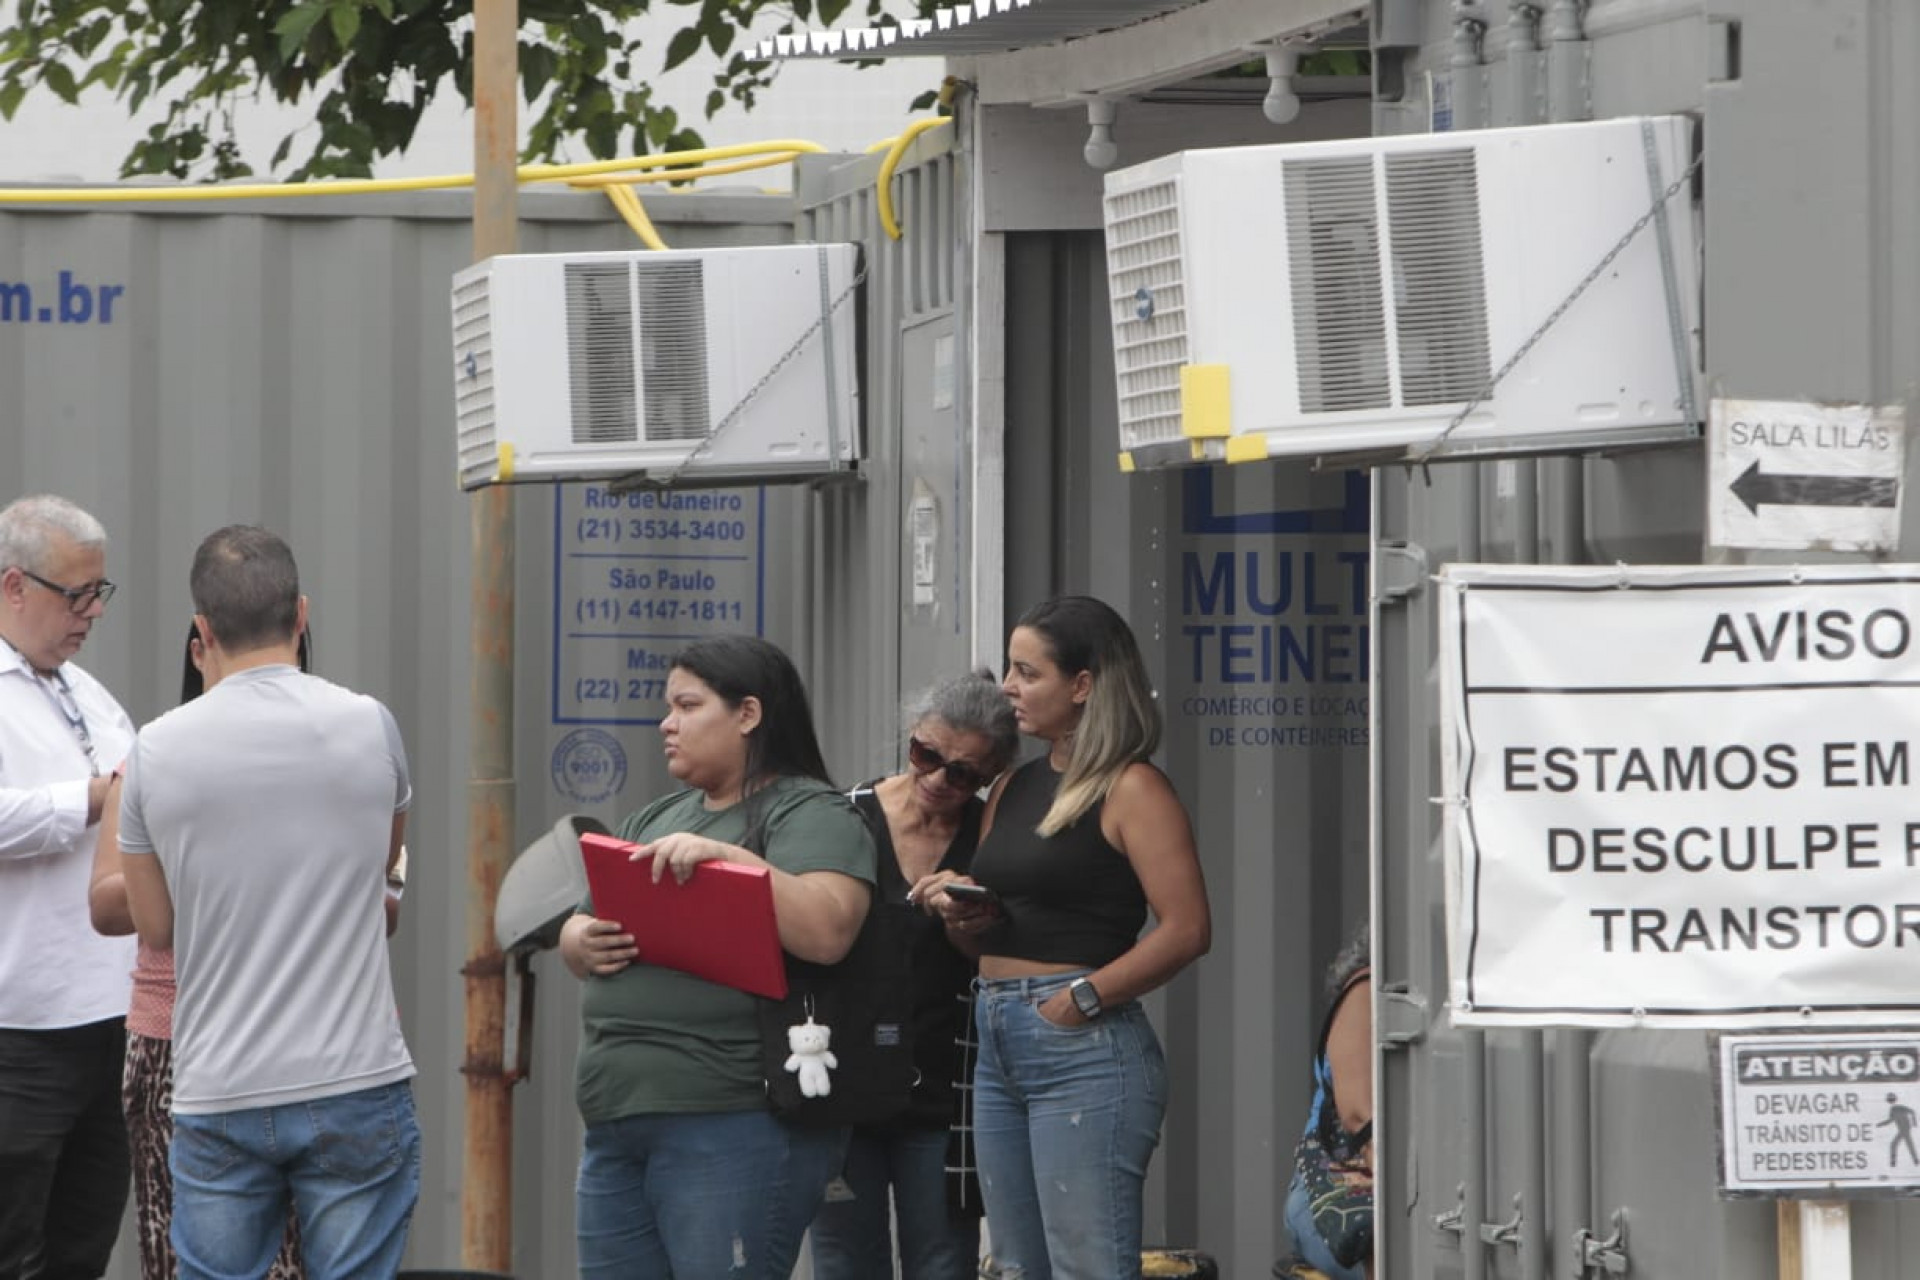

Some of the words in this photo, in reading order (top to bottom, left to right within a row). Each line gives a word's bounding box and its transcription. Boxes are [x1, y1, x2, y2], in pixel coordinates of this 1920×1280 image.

[1731, 421, 1806, 446] SALA
[1816, 421, 1890, 451] LILÁS
[584, 487, 621, 510] Rio
[628, 487, 655, 510] de
[659, 488, 742, 511] Janeiro
[577, 518, 622, 542] (21)
[629, 519, 745, 541] 3534-3400
[609, 568, 651, 589] São
[657, 569, 716, 591] Paulo
[576, 600, 621, 623] (11)
[627, 602, 742, 621] 4147-1811
[1701, 608, 1911, 664] AVISO
[576, 678, 619, 704] (22)
[1182, 696, 1288, 717] COMÉRCIO
[1293, 698, 1304, 717] E
[1209, 727, 1235, 747] DE
[1504, 743, 1800, 793] ESTAMOS
[1823, 741, 1909, 788] EM
[1548, 823, 1881, 873] DESCULPE
[1590, 904, 1920, 953] TRANSTOR
[1744, 1050, 1916, 1081] ATENÇÃO
[1755, 1092, 1860, 1116] DEVAGAR
[1745, 1119, 1841, 1144] TRÂNSITO
[1847, 1122, 1874, 1143] DE
[1753, 1150, 1868, 1172] PEDESTRES
